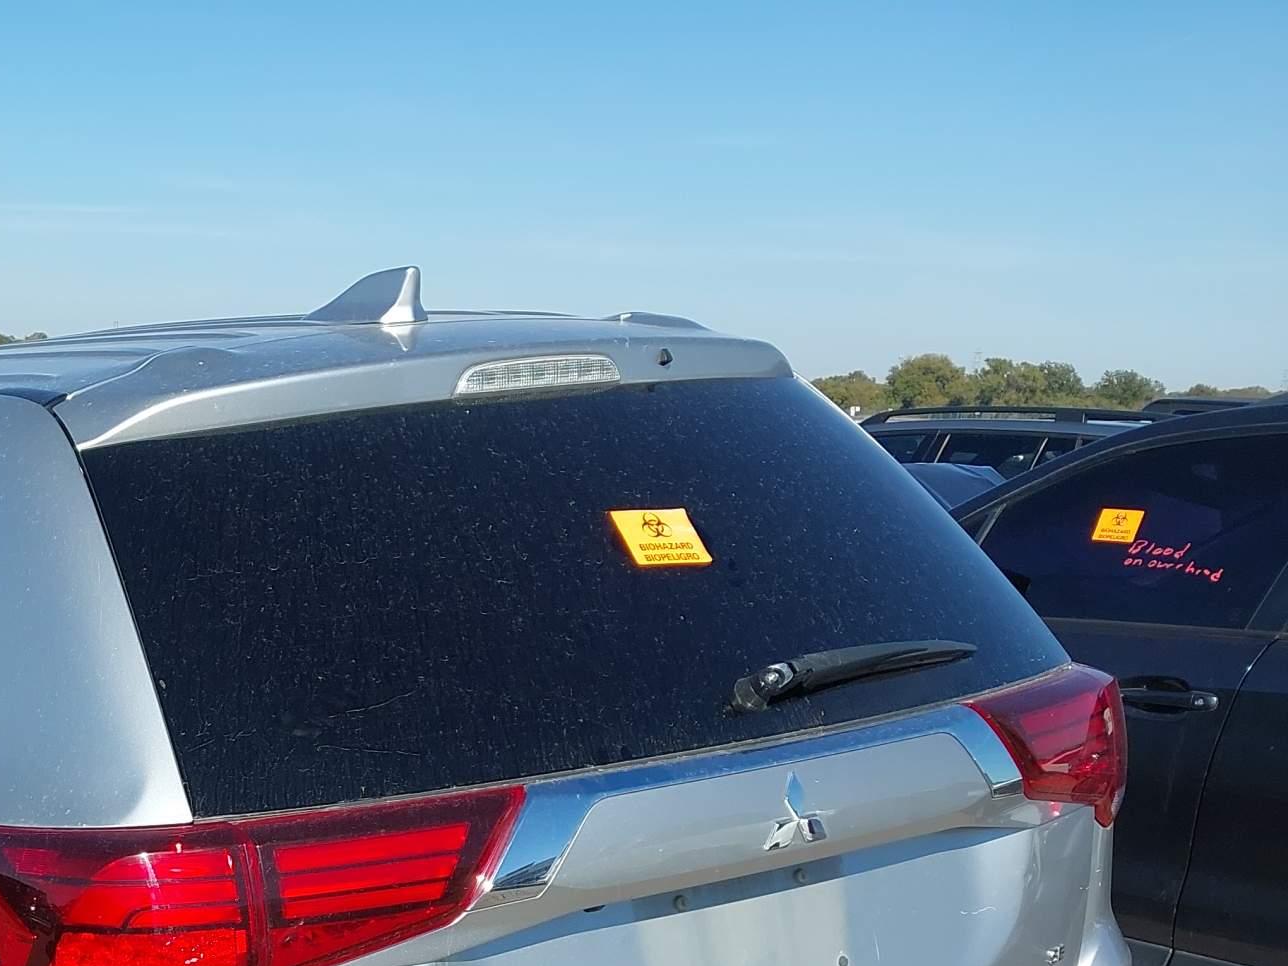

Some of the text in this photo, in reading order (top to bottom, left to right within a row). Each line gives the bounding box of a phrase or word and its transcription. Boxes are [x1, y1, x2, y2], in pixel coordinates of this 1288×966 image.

[639, 542, 694, 552] BIOHAZARD
[1128, 540, 1191, 558] Blood
[644, 552, 700, 562] BIOPELIGRO
